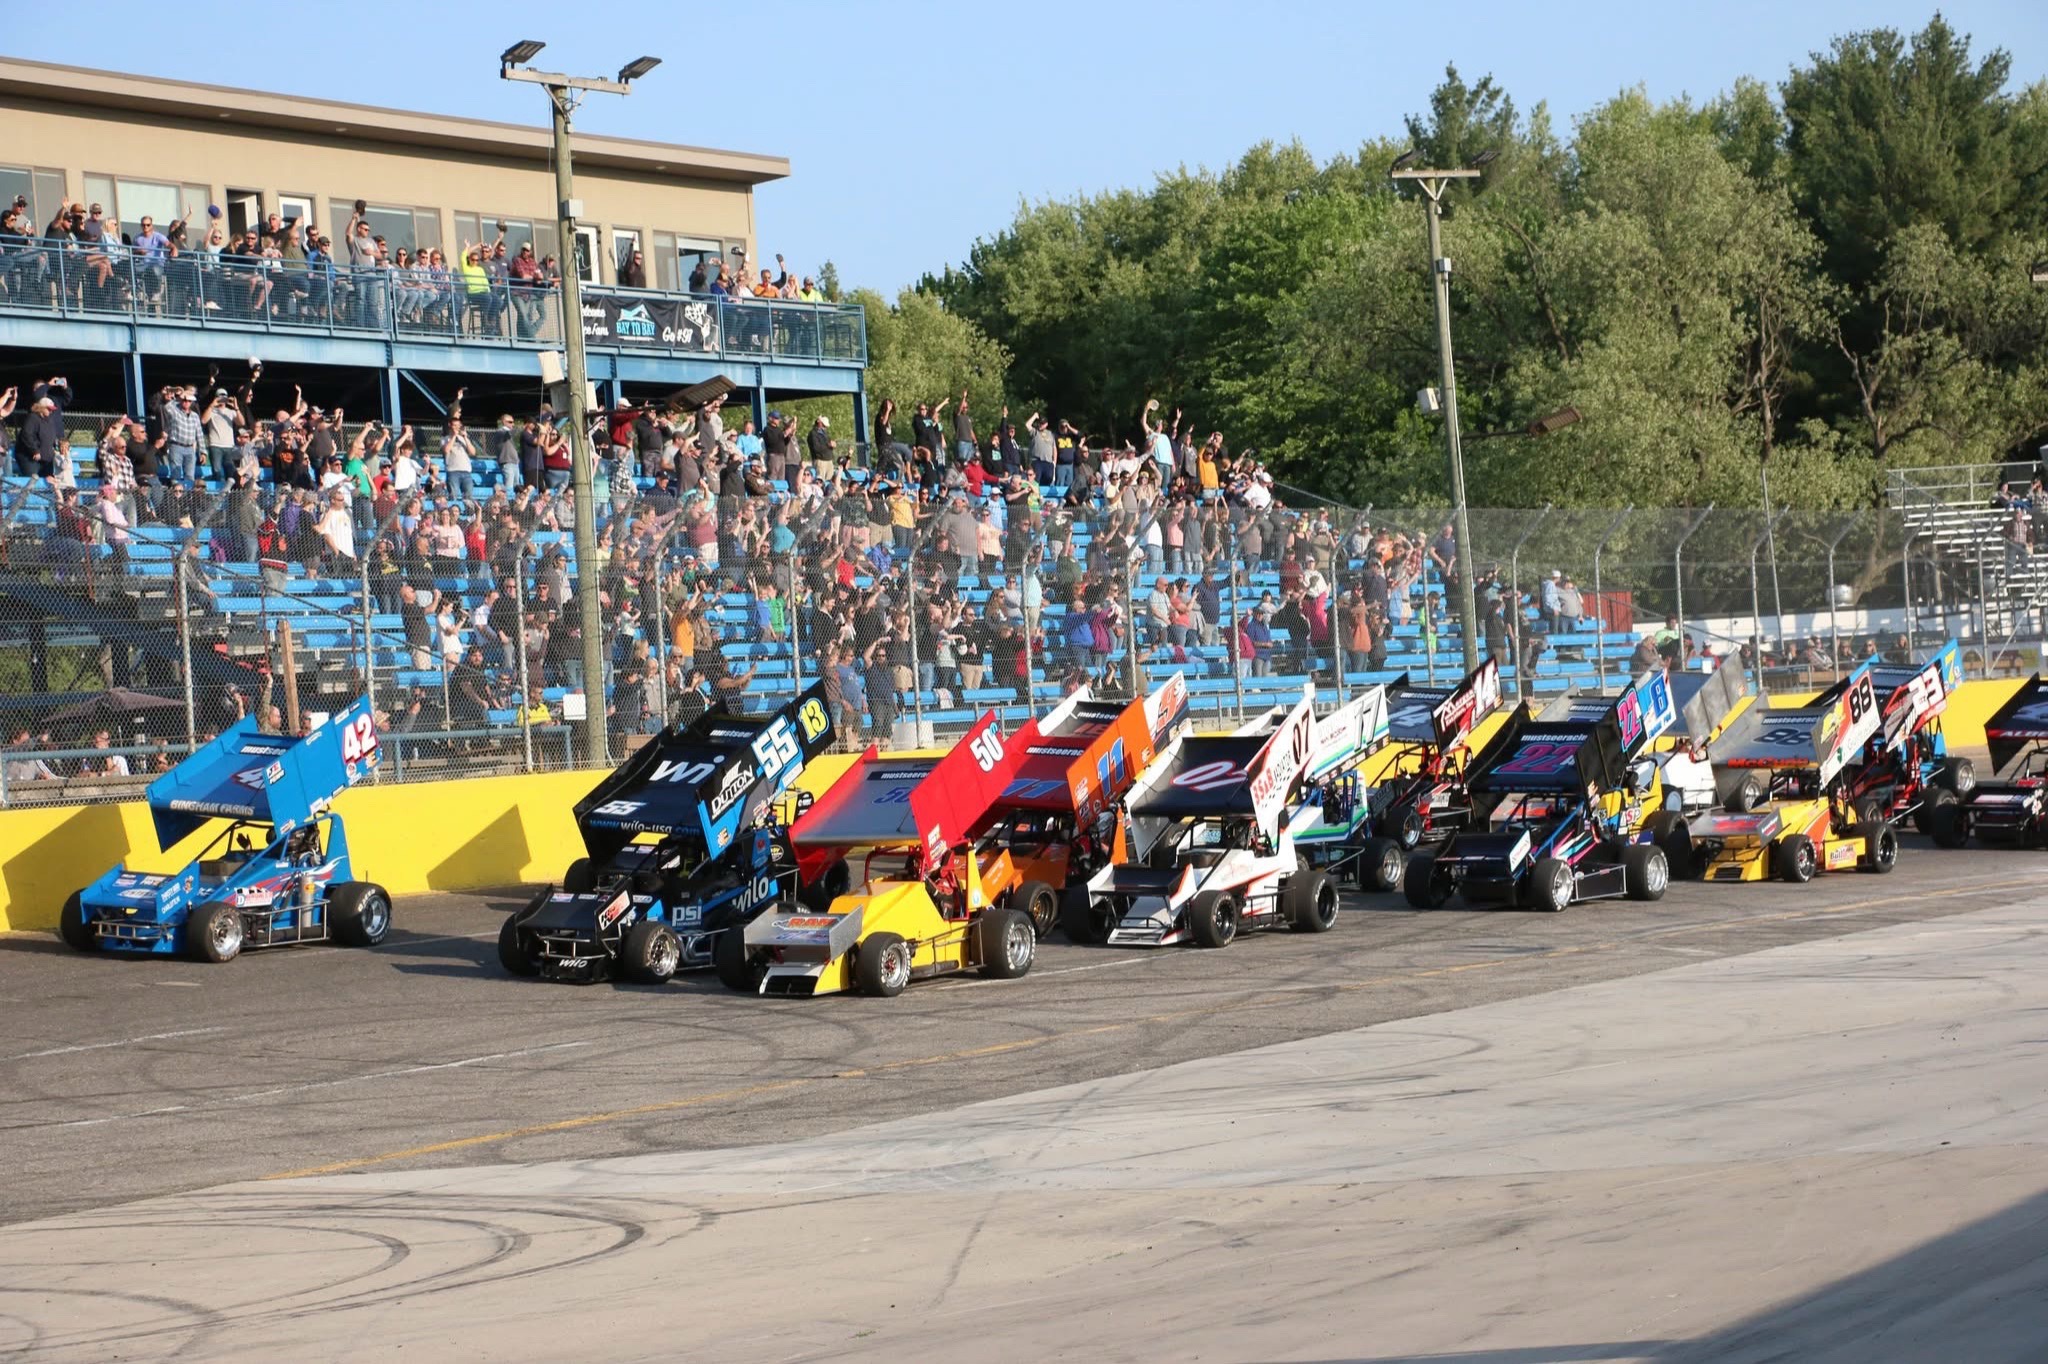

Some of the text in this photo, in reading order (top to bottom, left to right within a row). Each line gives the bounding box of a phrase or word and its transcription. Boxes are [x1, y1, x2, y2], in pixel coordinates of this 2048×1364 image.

[581, 304, 606, 318] elcome
[592, 323, 609, 336] Fans
[616, 321, 656, 336] BAY TO BAY
[663, 326, 693, 343] Go #97
[1058, 437, 1073, 448] M
[1650, 673, 1669, 718] 8
[1849, 676, 1873, 725] 88
[1908, 665, 1945, 716] 23
[798, 698, 830, 744] 13
[1293, 709, 1310, 766] 07
[1354, 692, 1382, 753] 17
[1616, 686, 1643, 753] 22
[1755, 728, 1812, 746] 88
[344, 714, 378, 765] 42
[751, 714, 801, 782] 55
[969, 727, 1004, 772] 50
[1490, 741, 1583, 775] 22
[1097, 736, 1126, 800] 11
[711, 766, 753, 814] DUTTON
[1002, 778, 1067, 798] 11
[170, 799, 255, 816] BINGHAM FARMS
[593, 800, 648, 816] 55
[732, 876, 769, 914] wilo
[672, 905, 702, 927] psi
[559, 958, 588, 968] wilo
